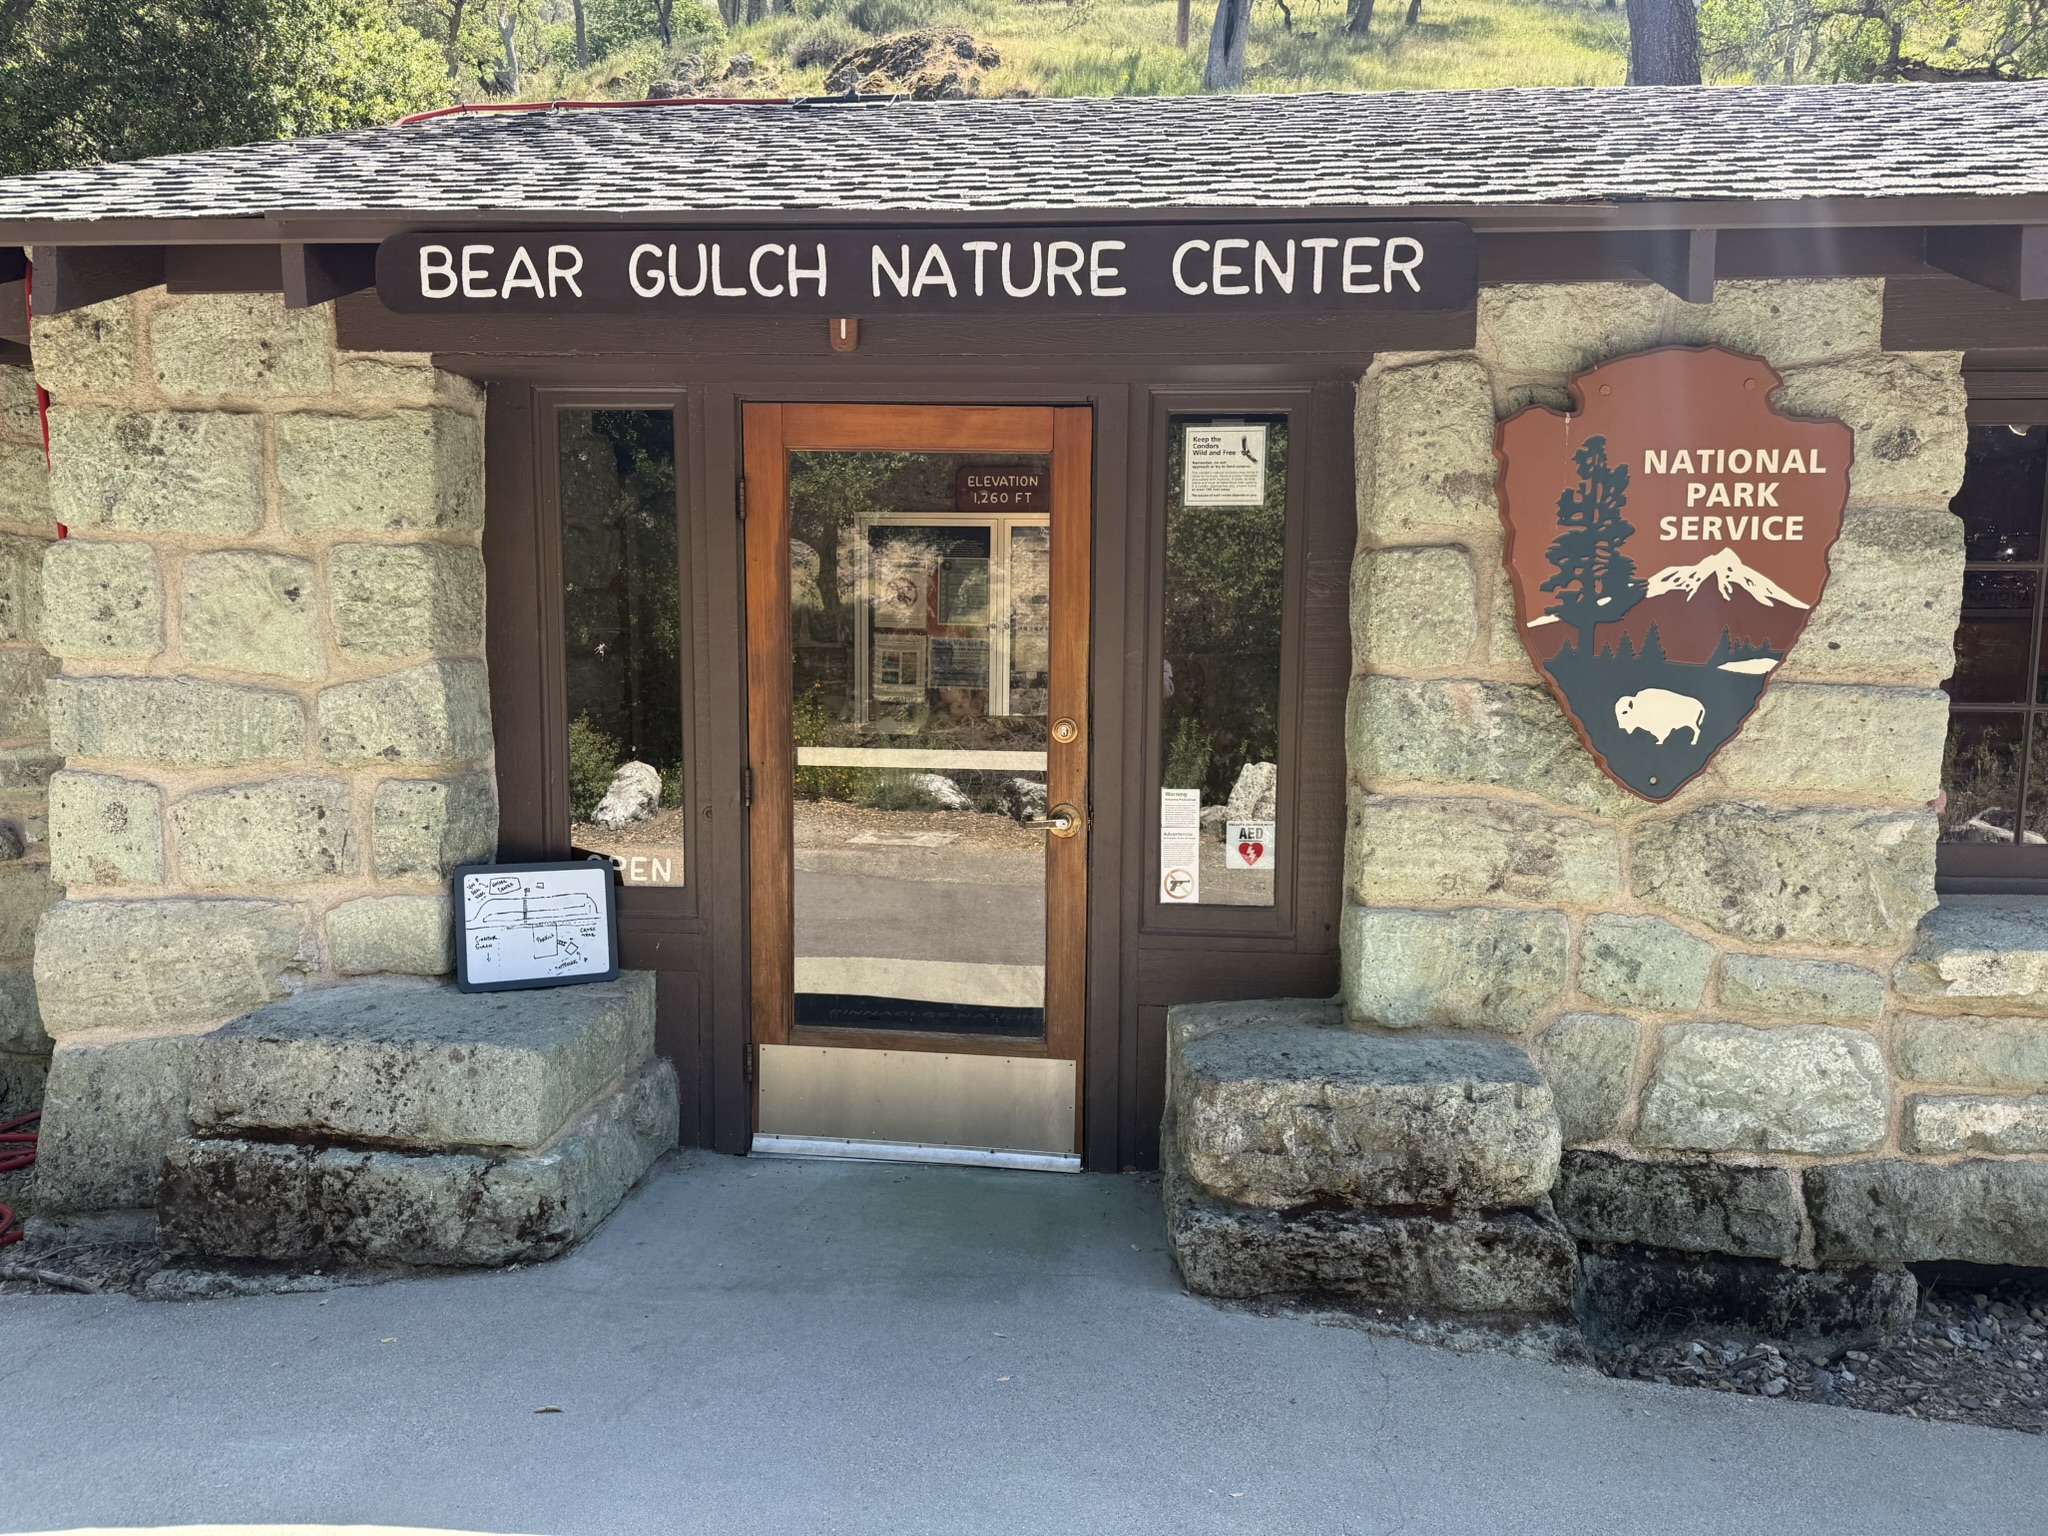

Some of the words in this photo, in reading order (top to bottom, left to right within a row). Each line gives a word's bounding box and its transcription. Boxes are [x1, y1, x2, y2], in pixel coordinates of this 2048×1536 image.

[419, 245, 583, 298] BEAR
[629, 243, 827, 297] GULCH
[872, 241, 1127, 298] NATURE
[1172, 237, 1424, 295] CENTER
[1644, 449, 1827, 475] NATIONAL
[967, 475, 1039, 487] ELEVATION
[974, 492, 1009, 504] 1,260
[1015, 492, 1032, 503] FT
[1687, 482, 1780, 508] PARK
[1659, 515, 1805, 541] SERVICE
[1239, 827, 1264, 840] AED
